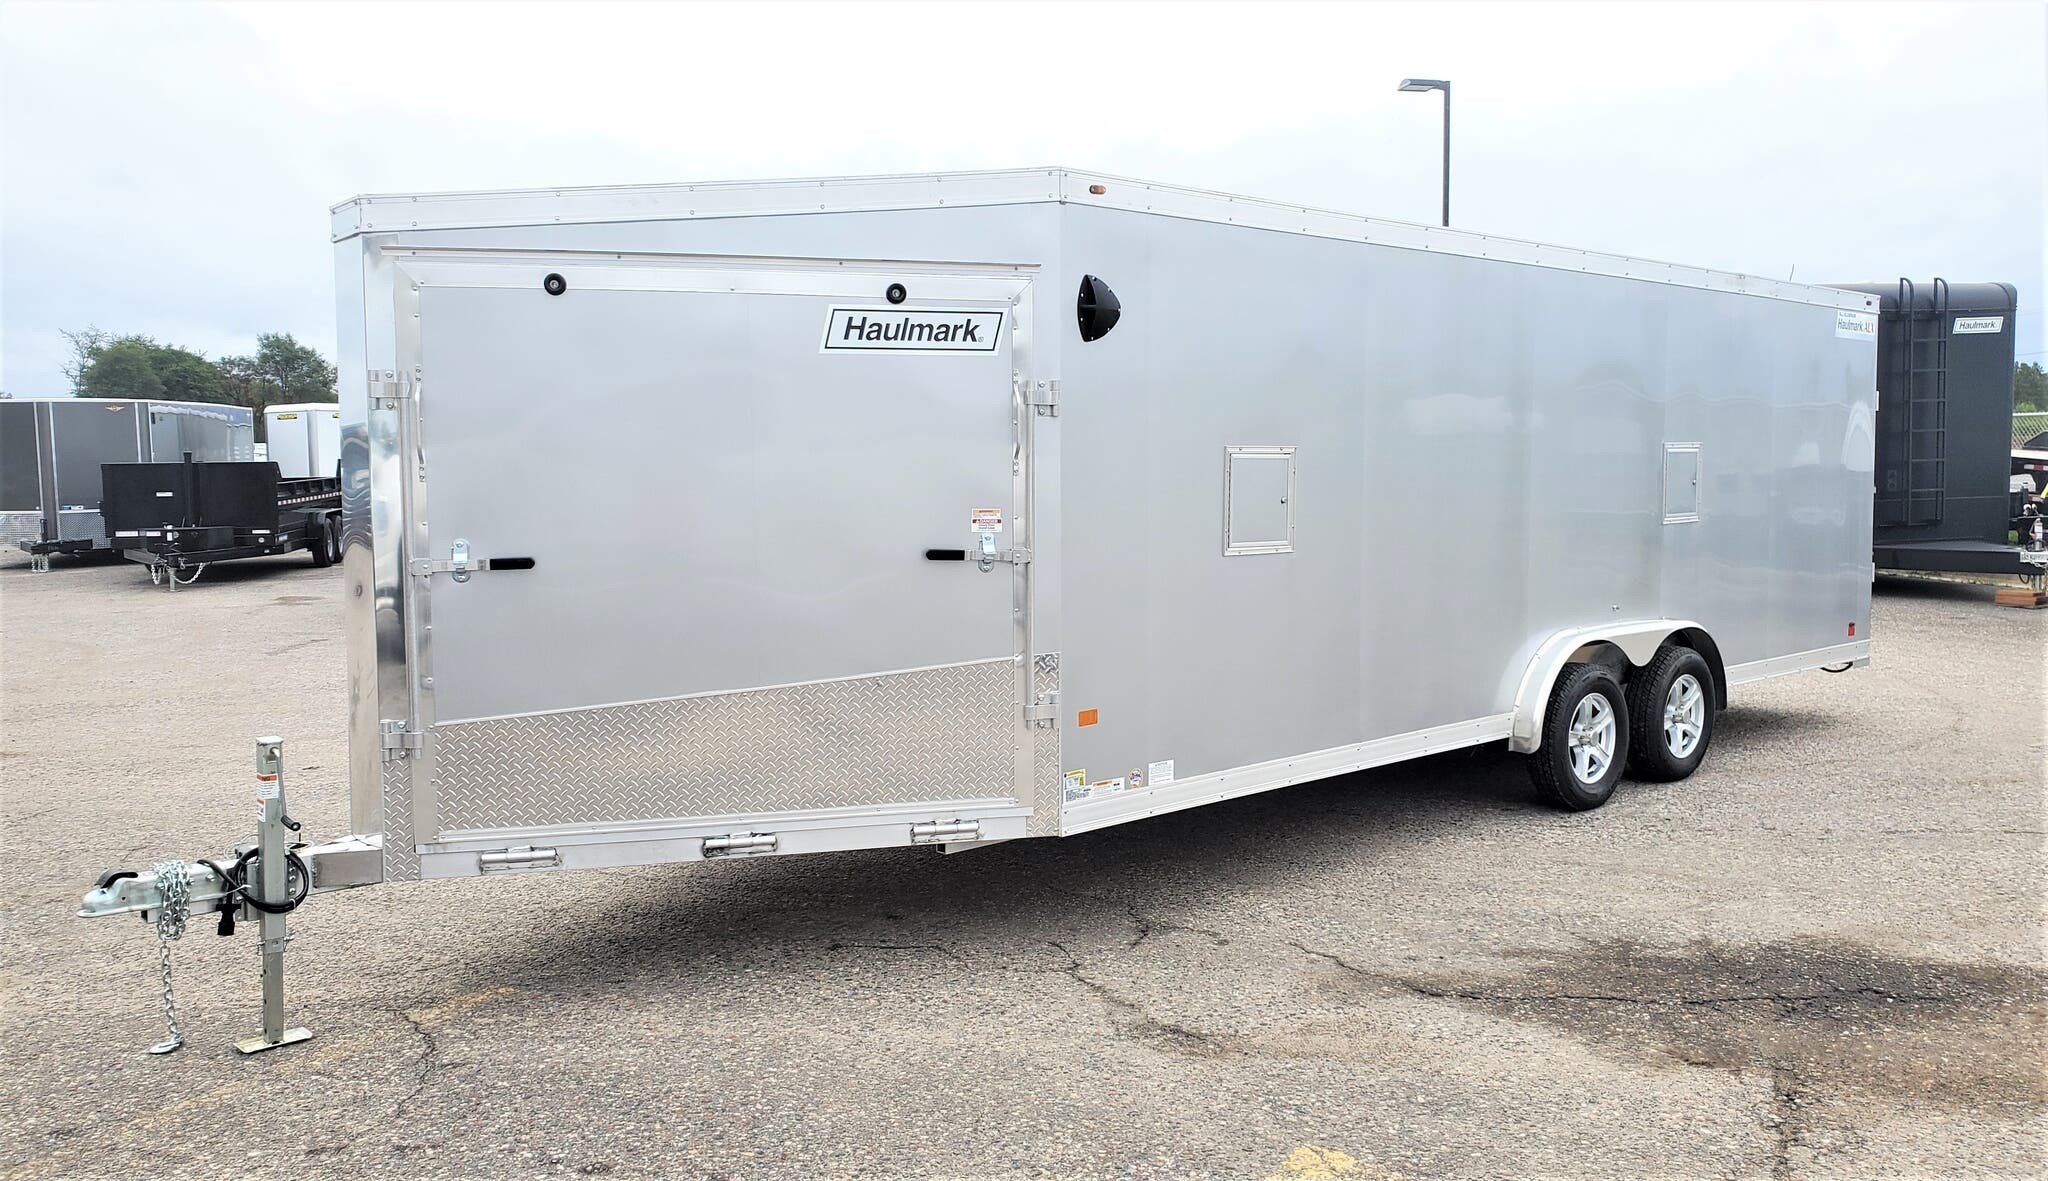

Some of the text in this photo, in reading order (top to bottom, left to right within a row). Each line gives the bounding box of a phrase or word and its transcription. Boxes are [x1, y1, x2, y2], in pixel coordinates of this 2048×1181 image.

[843, 316, 981, 343] Haulmark
[1837, 317, 1863, 332] Haulmark
[1958, 320, 1996, 330] Haulmark
